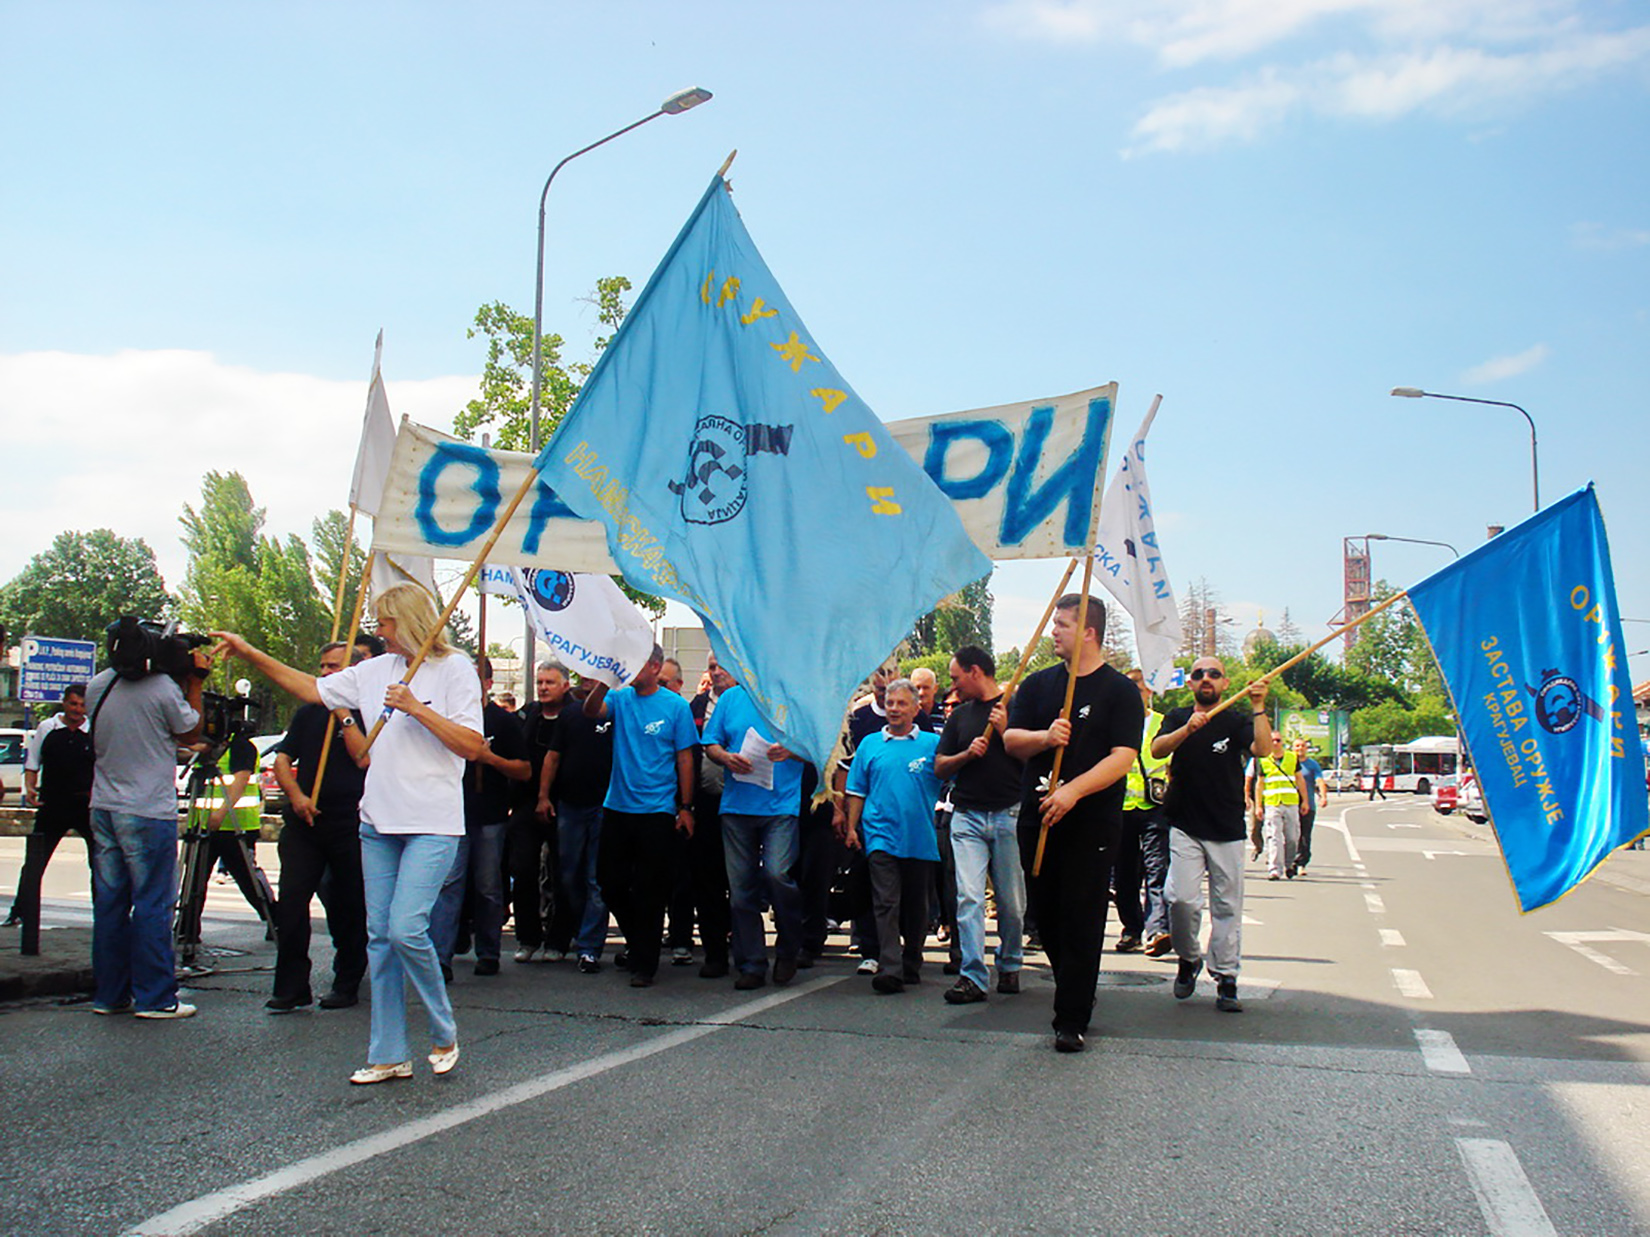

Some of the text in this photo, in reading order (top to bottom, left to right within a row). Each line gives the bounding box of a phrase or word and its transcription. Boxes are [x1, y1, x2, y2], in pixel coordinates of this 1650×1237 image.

[1481, 635, 1565, 826] ЗАСТАВА ОРУЖЈЕ
[1483, 692, 1528, 789] КРАГУЈЕВАЦ
